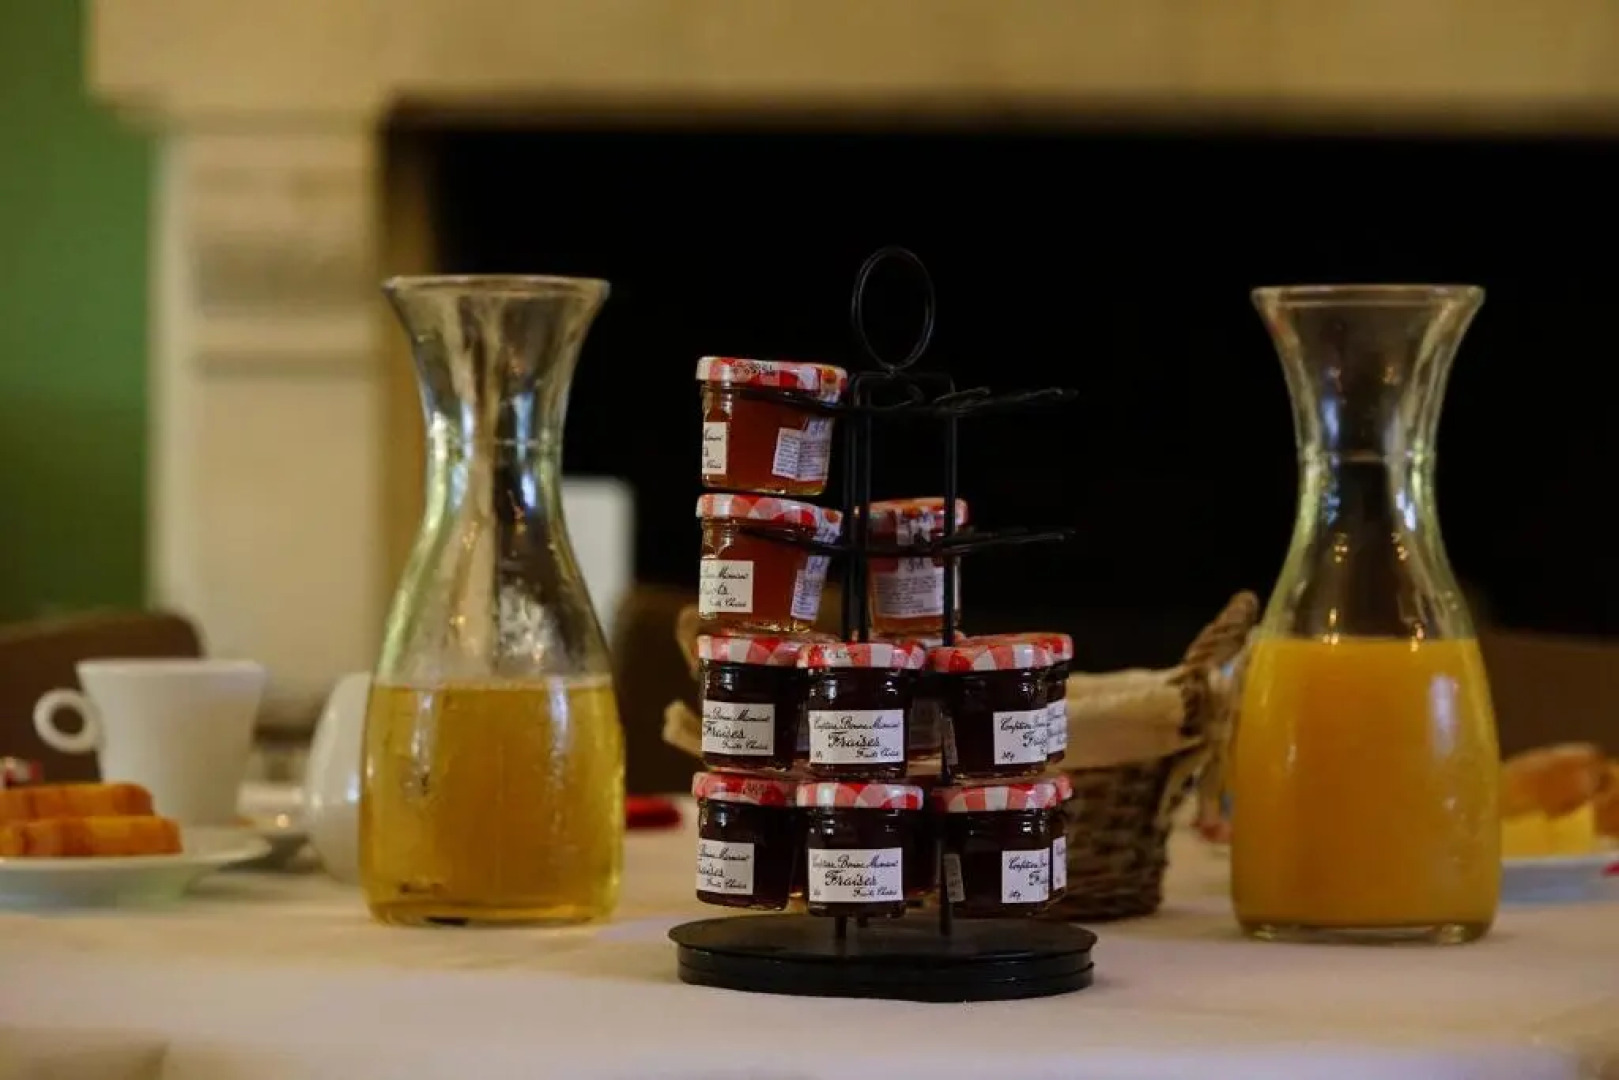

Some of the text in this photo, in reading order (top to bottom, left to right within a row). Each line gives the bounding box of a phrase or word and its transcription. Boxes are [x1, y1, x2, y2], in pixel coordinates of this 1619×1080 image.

[827, 729, 881, 749] Fraises
[837, 853, 866, 869] Bonne
[824, 868, 878, 888] Fraises
